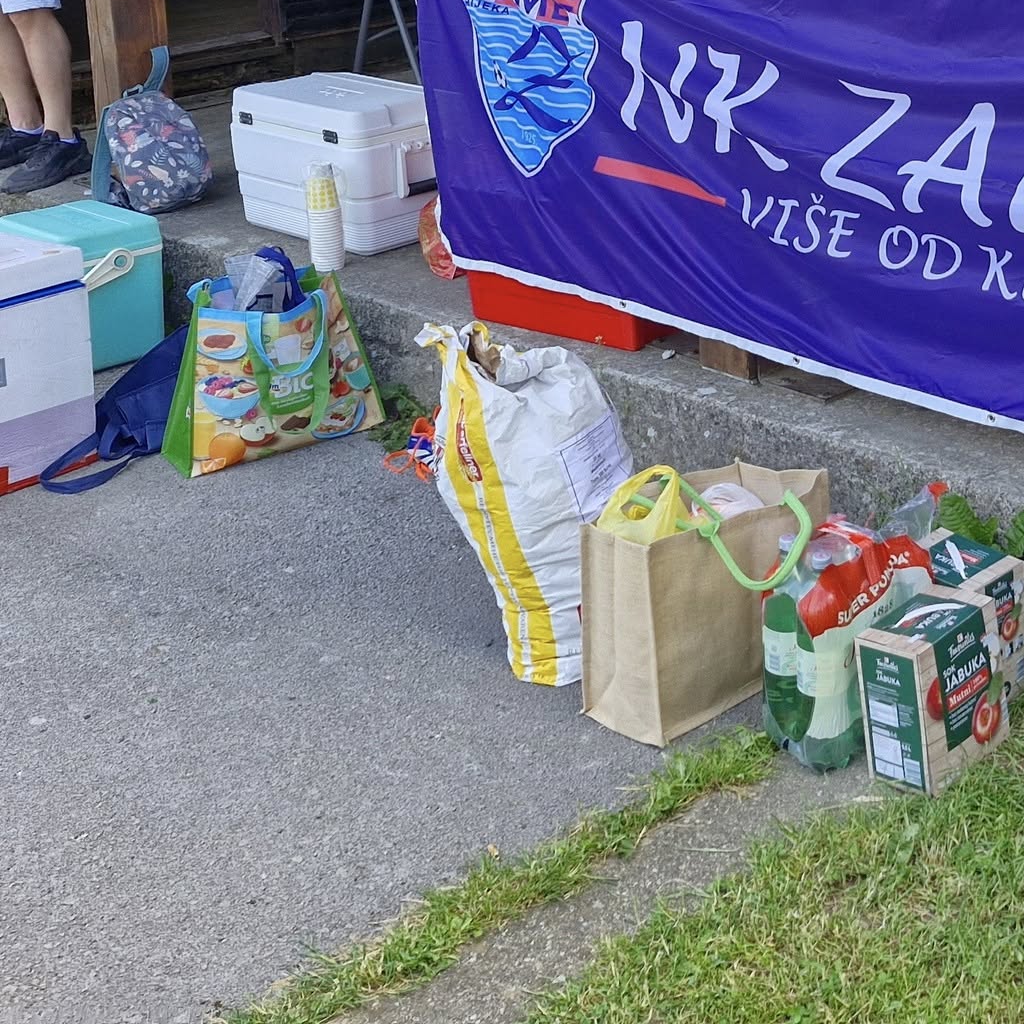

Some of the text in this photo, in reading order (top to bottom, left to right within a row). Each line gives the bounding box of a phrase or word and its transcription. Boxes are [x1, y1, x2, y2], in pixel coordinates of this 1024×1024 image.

[620, 20, 788, 173] NK
[741, 188, 861, 258] VIŠE
[878, 225, 963, 280] OD
[837, 592, 870, 625] SUER
[943, 663, 957, 679] SOK
[945, 651, 987, 693] JABUKA
[949, 684, 972, 708] Mutni
